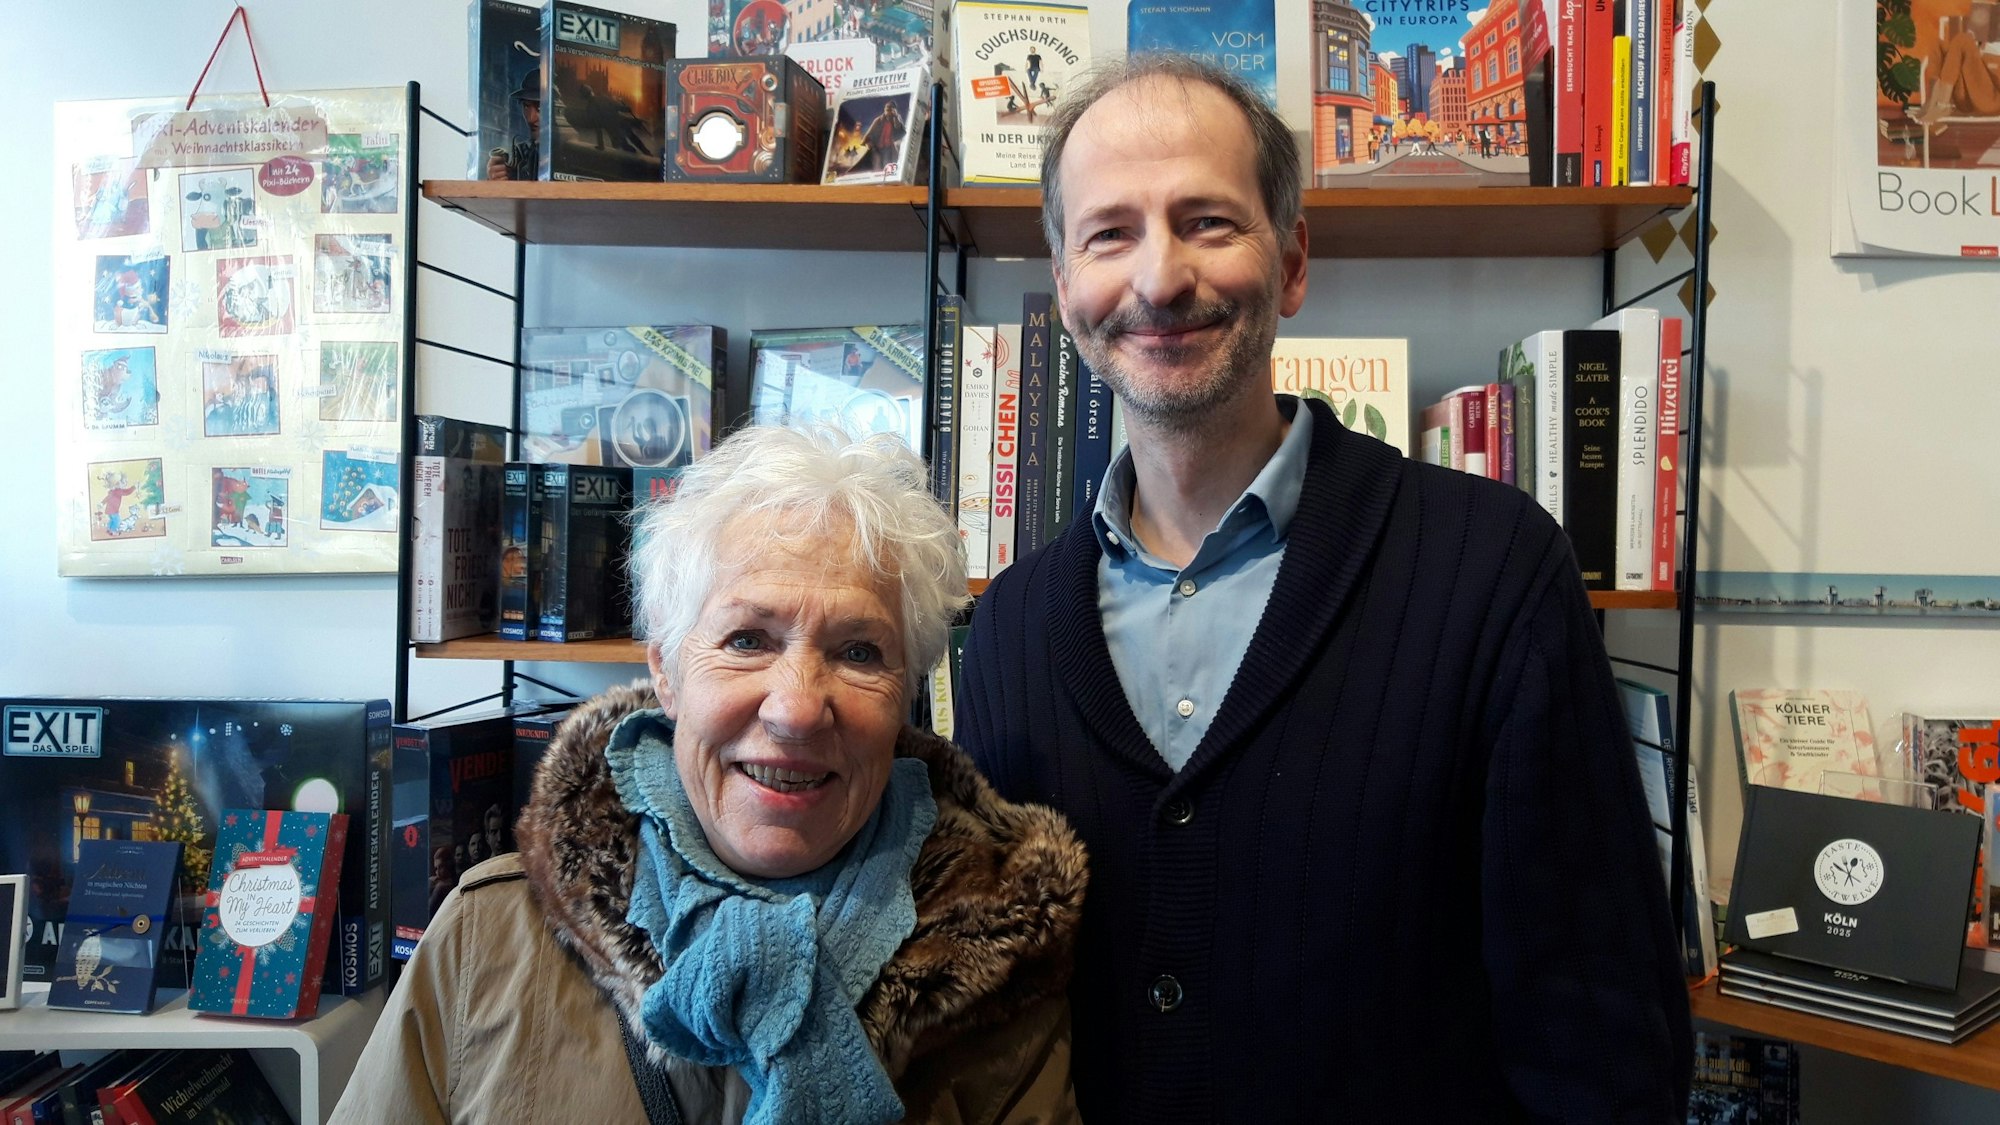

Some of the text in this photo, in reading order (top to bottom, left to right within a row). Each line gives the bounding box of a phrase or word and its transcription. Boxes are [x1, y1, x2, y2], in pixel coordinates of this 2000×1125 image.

[517, 7, 531, 15] ZWEI
[1169, 6, 1211, 14] SCHOMANN
[1365, 0, 1470, 14] CITYTRIPS
[559, 14, 616, 43] EXIT
[983, 13, 1067, 25] STEPHAN ORTH
[1377, 15, 1458, 25] IN EUROPA
[1211, 31, 1265, 48] VOM
[1662, 28, 1671, 50] Land
[1684, 10, 1694, 58] LISSABON
[975, 28, 1079, 67] COUCHSURFING
[1638, 40, 1646, 59] AUFS
[1224, 53, 1265, 71] DER
[1662, 52, 1671, 76] Stadt
[852, 71, 908, 88] DECKTECTIVE
[1637, 61, 1646, 99] NACHRUF
[981, 133, 1049, 145] IN DER UK
[995, 152, 1037, 161] Meine Reise
[1010, 161, 1026, 169] Land
[1680, 147, 1691, 177] CityTrip
[285, 164, 300, 175] 24
[1877, 172, 2000, 216] Book L
[869, 329, 888, 348] DAS
[1578, 363, 1608, 371] NIGEL
[939, 343, 954, 433] BLAUE STUNDE
[1056, 334, 1071, 428] La Cucina Romana
[1271, 355, 1391, 404] rangen
[1575, 374, 1610, 383] SLATER
[964, 391, 990, 399] DAVIES
[1026, 312, 1046, 466] MALAYSIA
[1660, 358, 1678, 436] Hitzefrei
[1548, 351, 1558, 464] HEALTHY made SIMPLE
[1589, 397, 1596, 405] A
[1087, 399, 1101, 440] órexi
[1487, 395, 1497, 429] TOMATEN
[1575, 407, 1610, 416] COOK'S
[962, 424, 989, 432] GOHAN
[1579, 418, 1606, 427] BOOK
[1632, 385, 1648, 466] SPLENDIDO
[994, 393, 1017, 518] SISSI CHEN
[415, 461, 424, 483] NICHT
[432, 461, 440, 479] TOTE
[506, 472, 525, 484] EXIT
[545, 473, 566, 486] EXIT
[424, 466, 432, 497] FRIEREN
[574, 475, 617, 497] EXIT
[447, 528, 472, 554] TOTE
[446, 582, 477, 610] NICHT
[368, 709, 390, 720] KOSMOS
[1775, 702, 1831, 714] KÖLNER
[1784, 715, 1826, 726] TIERE
[8, 711, 97, 752] EXIT
[32, 744, 95, 753] DAS SPIEL
[369, 770, 380, 910] ADVENTSKALENDER
[1822, 841, 1861, 858] TASTE
[241, 855, 288, 863] ADVENTSKALENDER
[228, 873, 295, 893] Christmas
[1832, 879, 1879, 902] TWELVE
[226, 896, 294, 921] My Heart
[1823, 912, 1858, 928] KÖLN
[1826, 926, 1852, 938] 2025
[344, 922, 358, 988] KOSMOS
[368, 925, 384, 977] EXIT
[161, 1052, 235, 1116] Wichtelweihnacht
